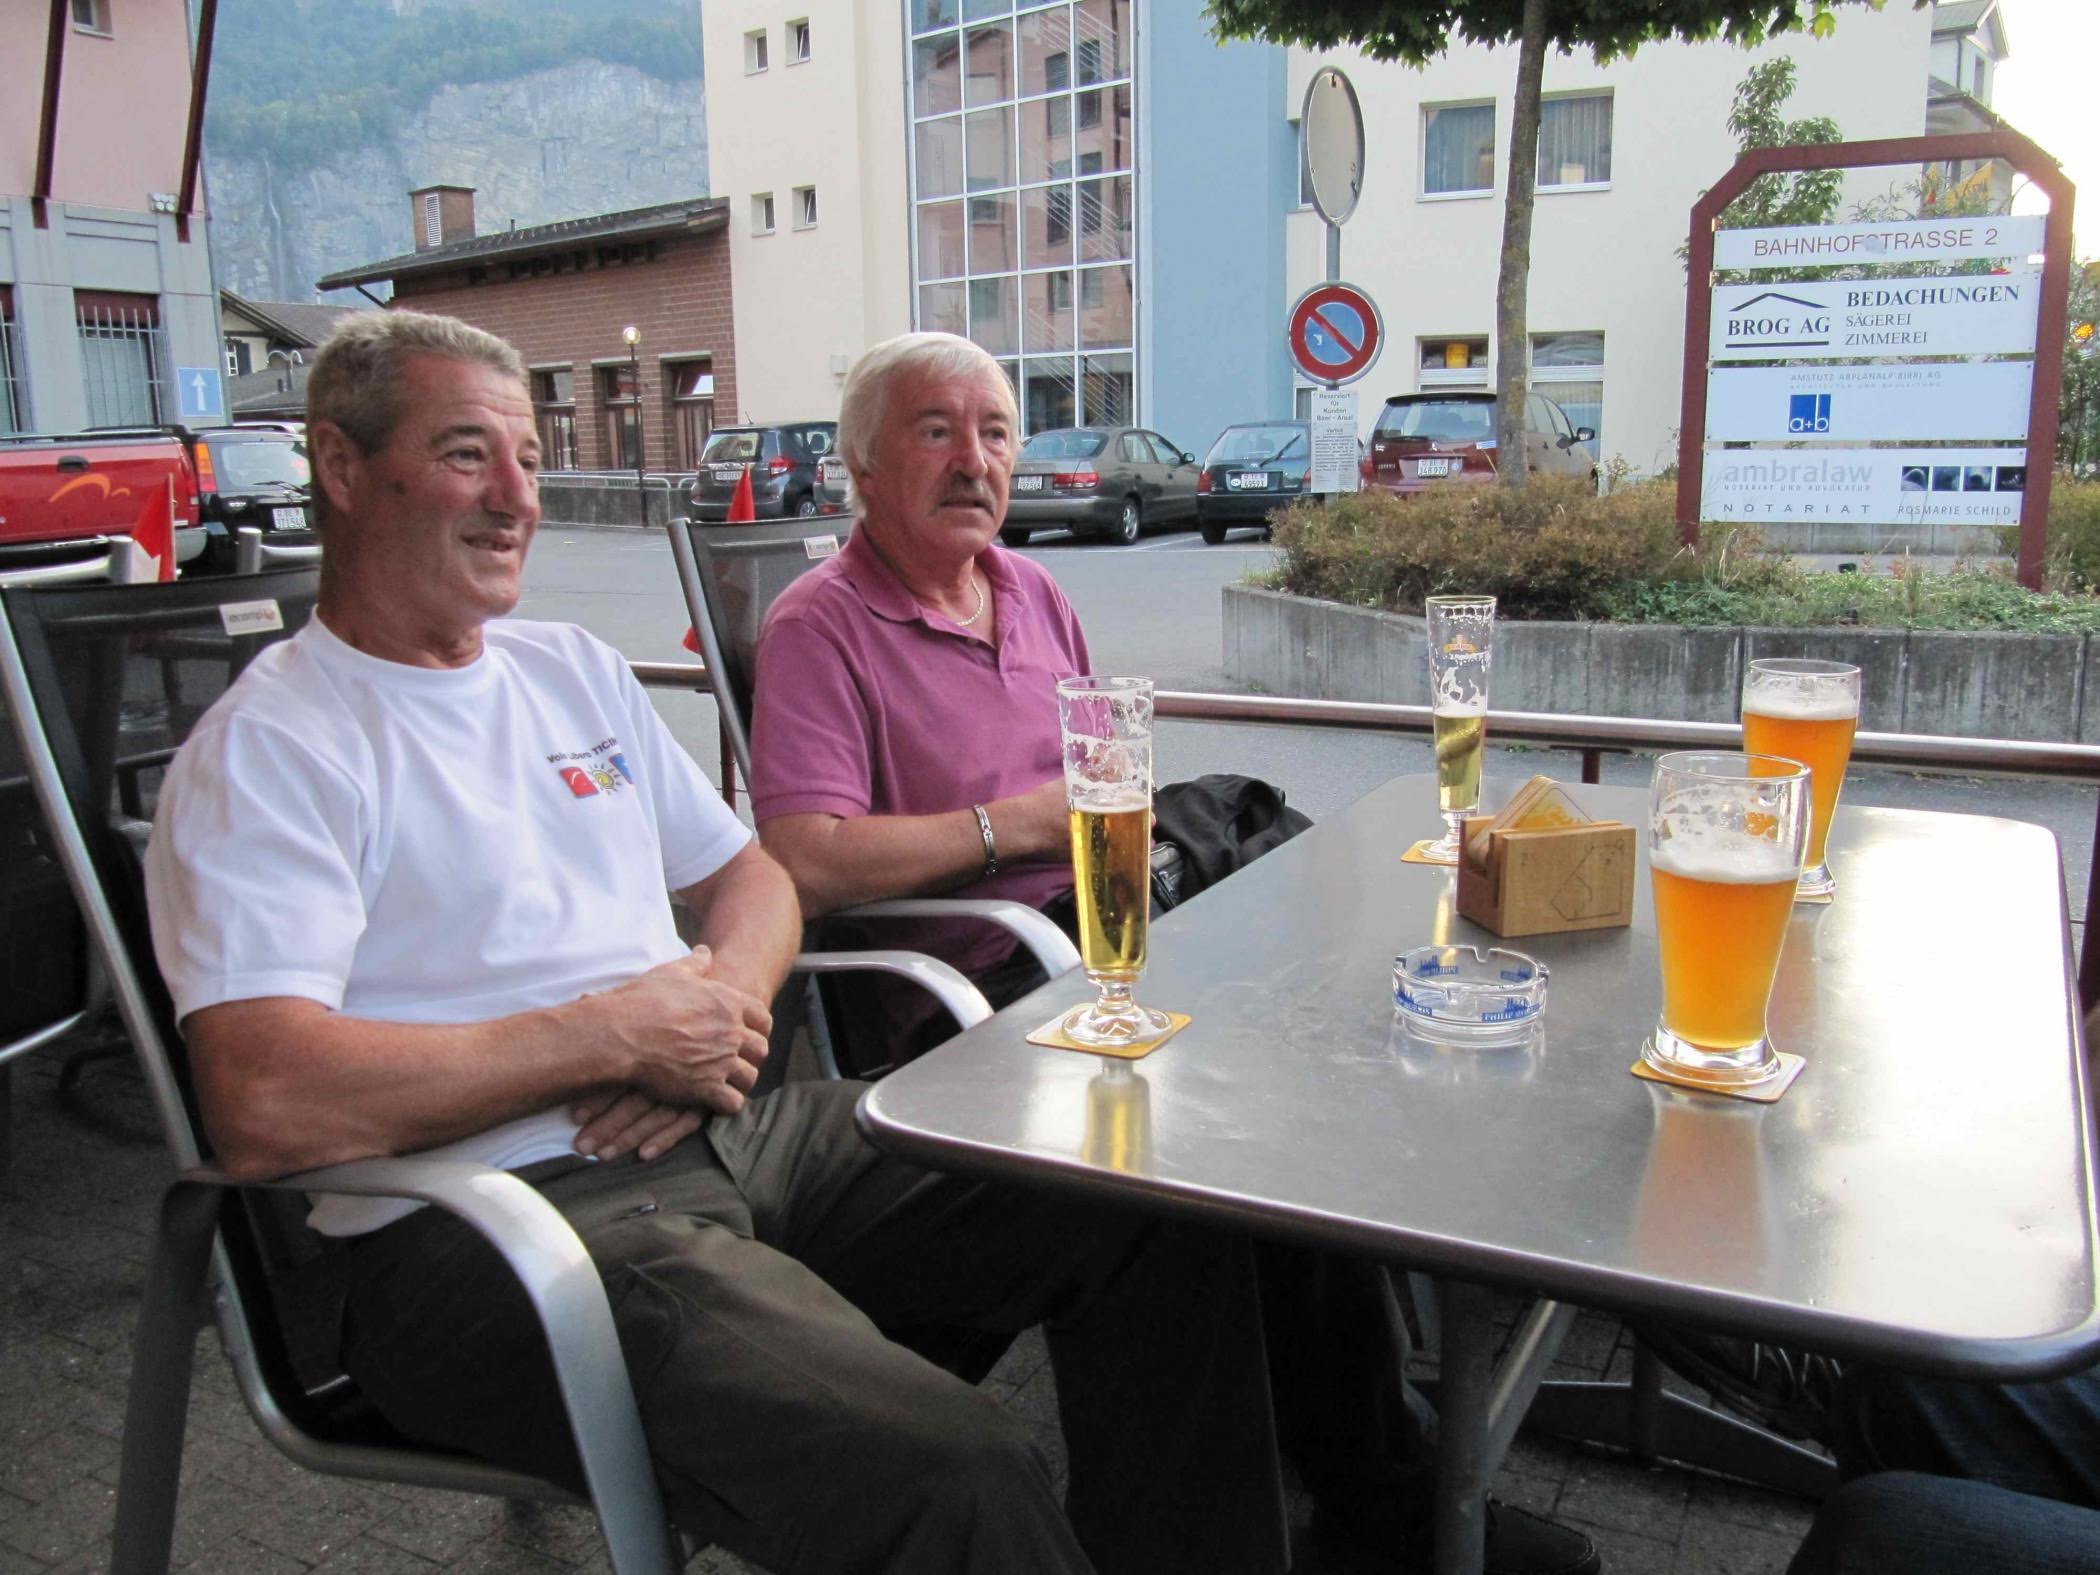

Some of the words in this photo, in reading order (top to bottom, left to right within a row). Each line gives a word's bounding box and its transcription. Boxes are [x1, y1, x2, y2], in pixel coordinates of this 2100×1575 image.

[1985, 228, 1998, 245] 2
[1847, 285, 2020, 307] BEDACHUNGEN
[1727, 318, 1790, 336] BROG
[1800, 316, 1830, 334] AG
[1845, 313, 1912, 328] SÄGEREI
[1844, 331, 1928, 346] ZIMMEREI
[1790, 373, 1834, 382] AMSTUTZ
[1927, 371, 1942, 379] AG
[1724, 459, 1873, 483] ambralaw
[1723, 504, 1870, 513] NOTARIAT
[1898, 505, 1961, 516] ROSMARIE
[1965, 505, 2011, 516] SCHILD
